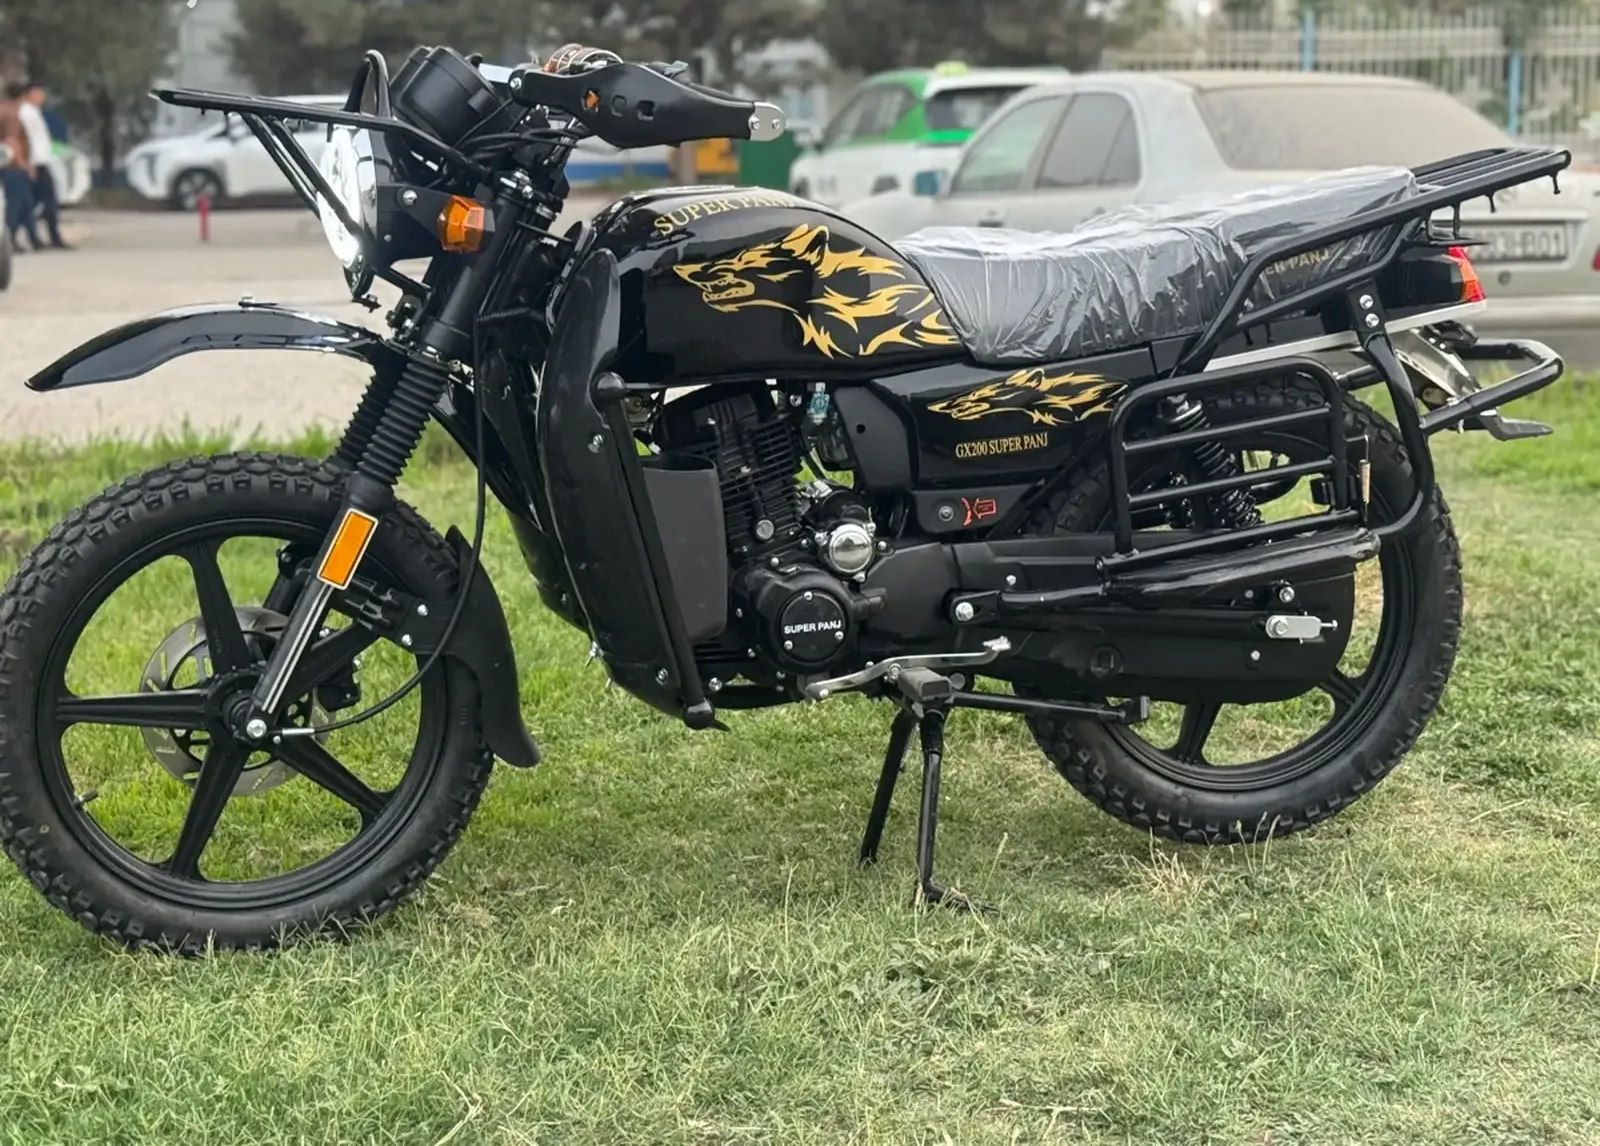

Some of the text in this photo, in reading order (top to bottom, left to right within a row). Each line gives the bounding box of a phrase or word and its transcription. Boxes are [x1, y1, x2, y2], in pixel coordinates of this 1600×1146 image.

[654, 198, 738, 236] SUPER
[955, 431, 1049, 458] GX200 SUPER PANJ
[784, 620, 842, 634] SUPER PANJ
